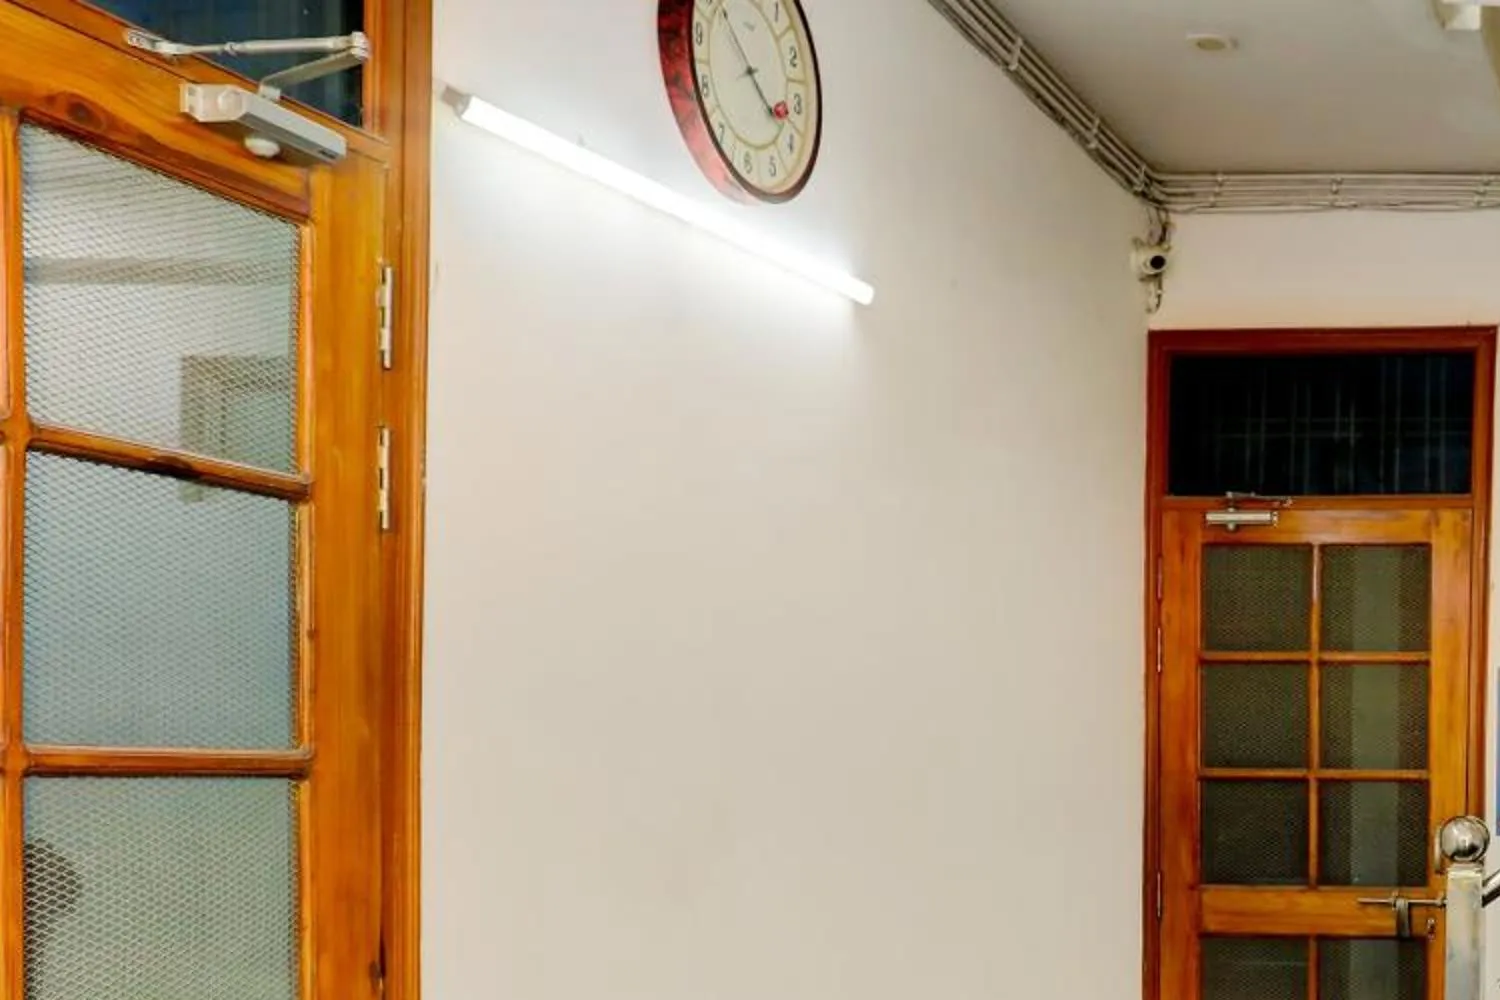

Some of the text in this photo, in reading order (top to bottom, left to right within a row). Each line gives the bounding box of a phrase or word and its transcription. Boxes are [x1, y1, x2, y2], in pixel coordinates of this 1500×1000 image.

[788, 47, 798, 68] 2
[793, 94, 802, 115] 3
[768, 156, 777, 178] 5
